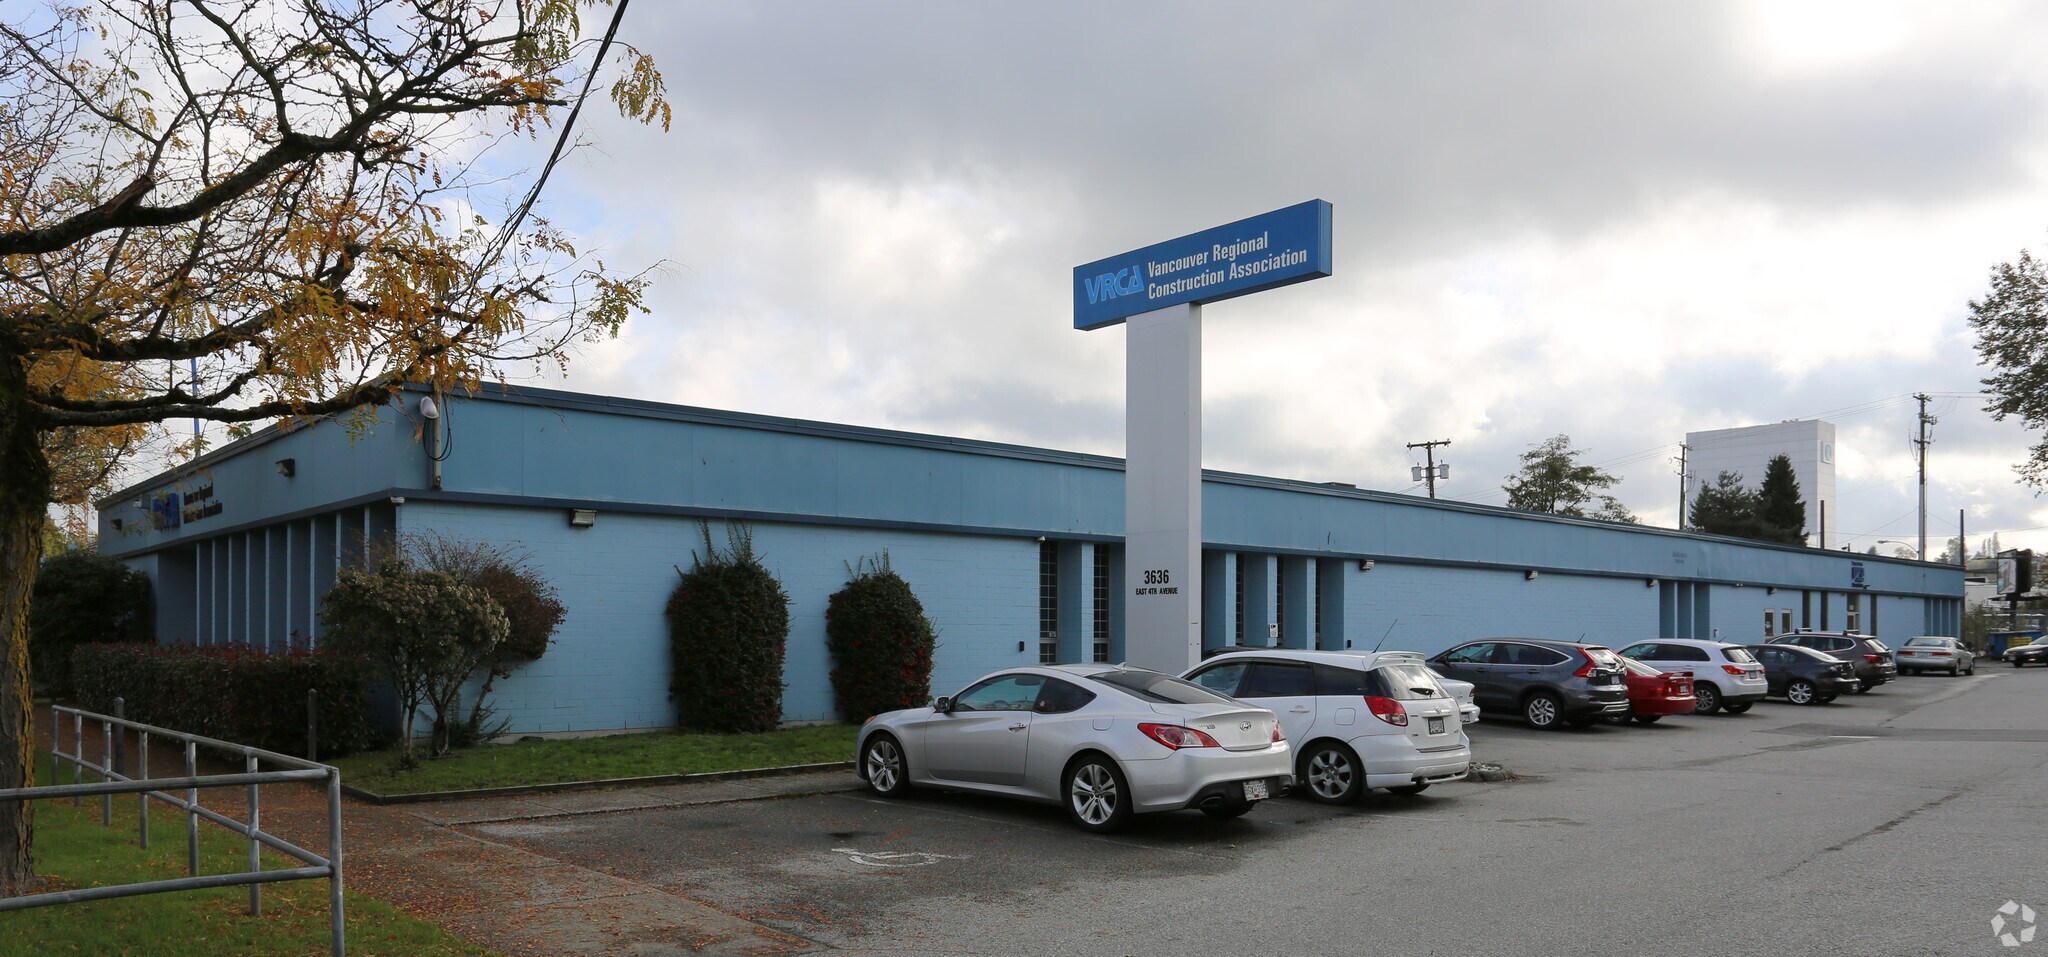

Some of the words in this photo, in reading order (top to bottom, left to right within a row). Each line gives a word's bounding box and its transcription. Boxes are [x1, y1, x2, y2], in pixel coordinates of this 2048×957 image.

[1148, 251, 1209, 278] Vancouver
[1213, 231, 1268, 261] Regional
[1084, 265, 1145, 304] VRCA
[1148, 269, 1224, 300] Construction
[1229, 249, 1307, 280] Association
[1144, 569, 1169, 584] 3636
[1148, 587, 1157, 595] 4TH
[1159, 587, 1178, 595] AVENUE
